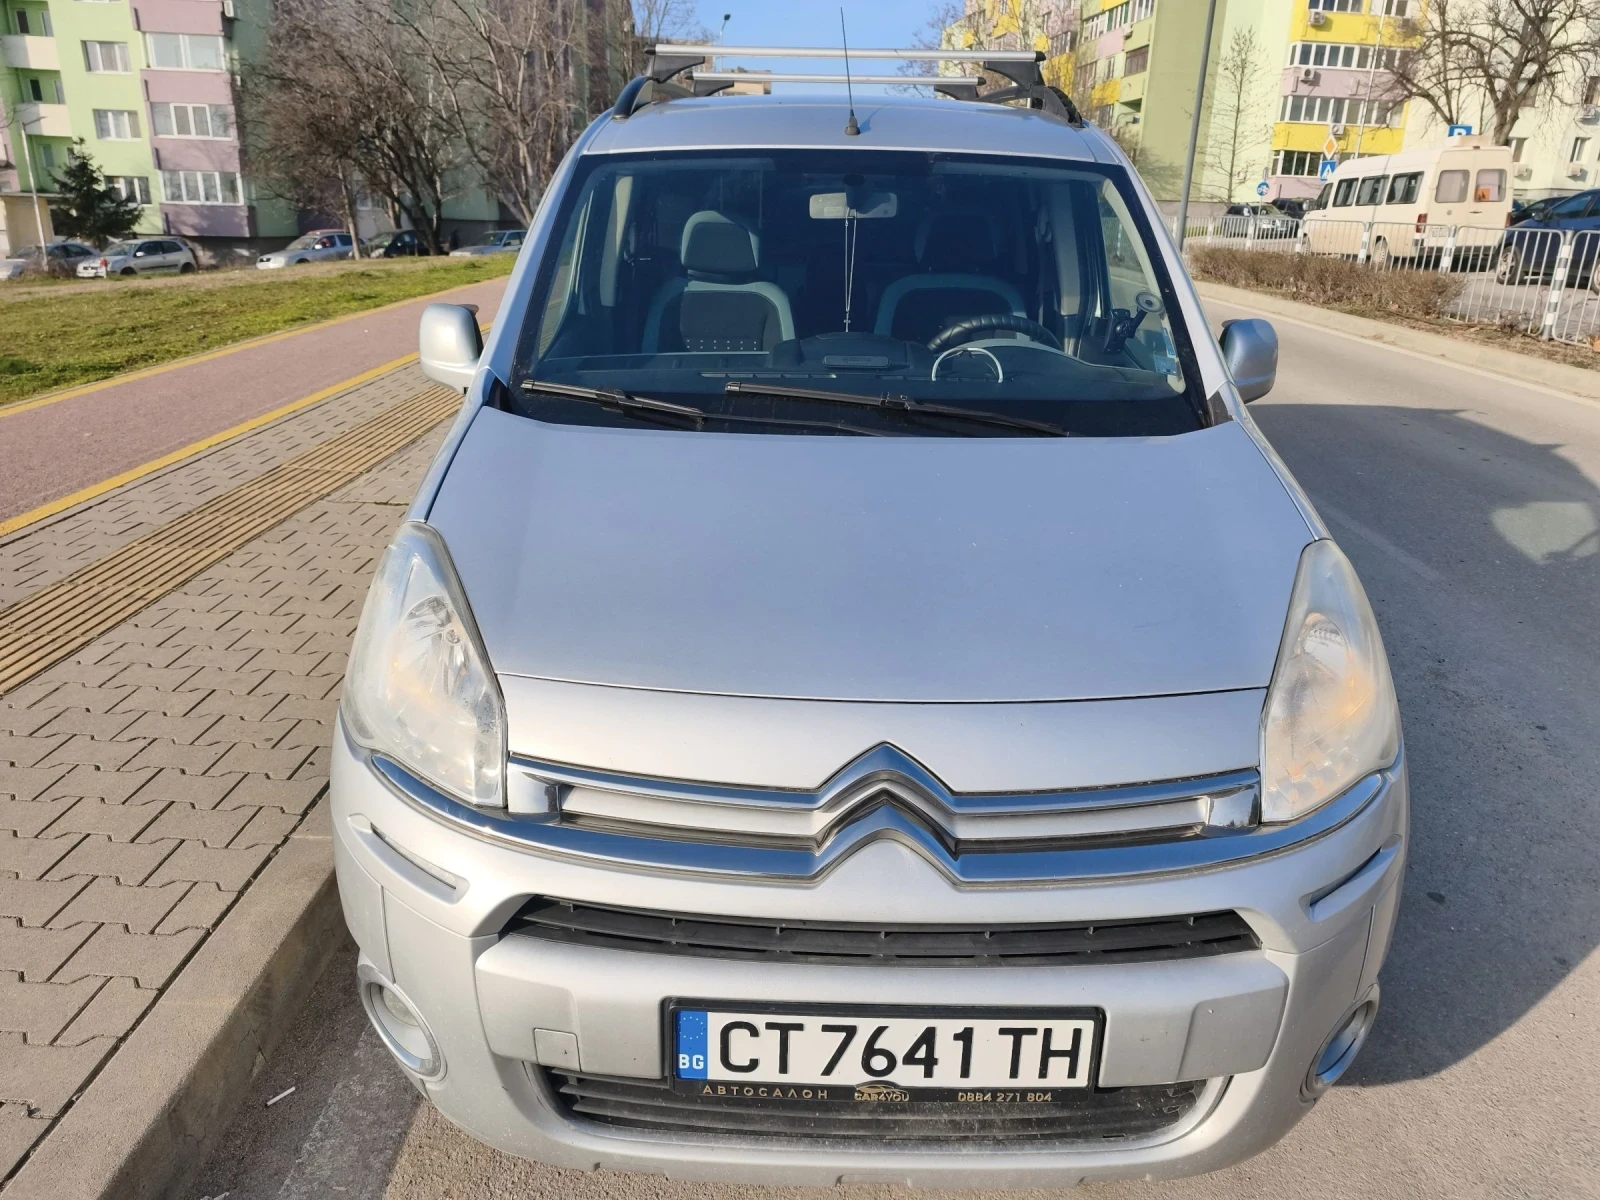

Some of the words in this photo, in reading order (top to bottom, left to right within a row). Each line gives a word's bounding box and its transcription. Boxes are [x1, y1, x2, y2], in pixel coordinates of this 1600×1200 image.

[719, 1020, 805, 1075] CT
[820, 1024, 975, 1079] 7641
[998, 1027, 1083, 1079] TH
[679, 1053, 705, 1070] BG
[702, 1084, 828, 1100] АВТОСАЛОН
[957, 1091, 993, 1103] 0884
[996, 1092, 1020, 1103] 271
[1026, 1091, 1053, 1103] 804
